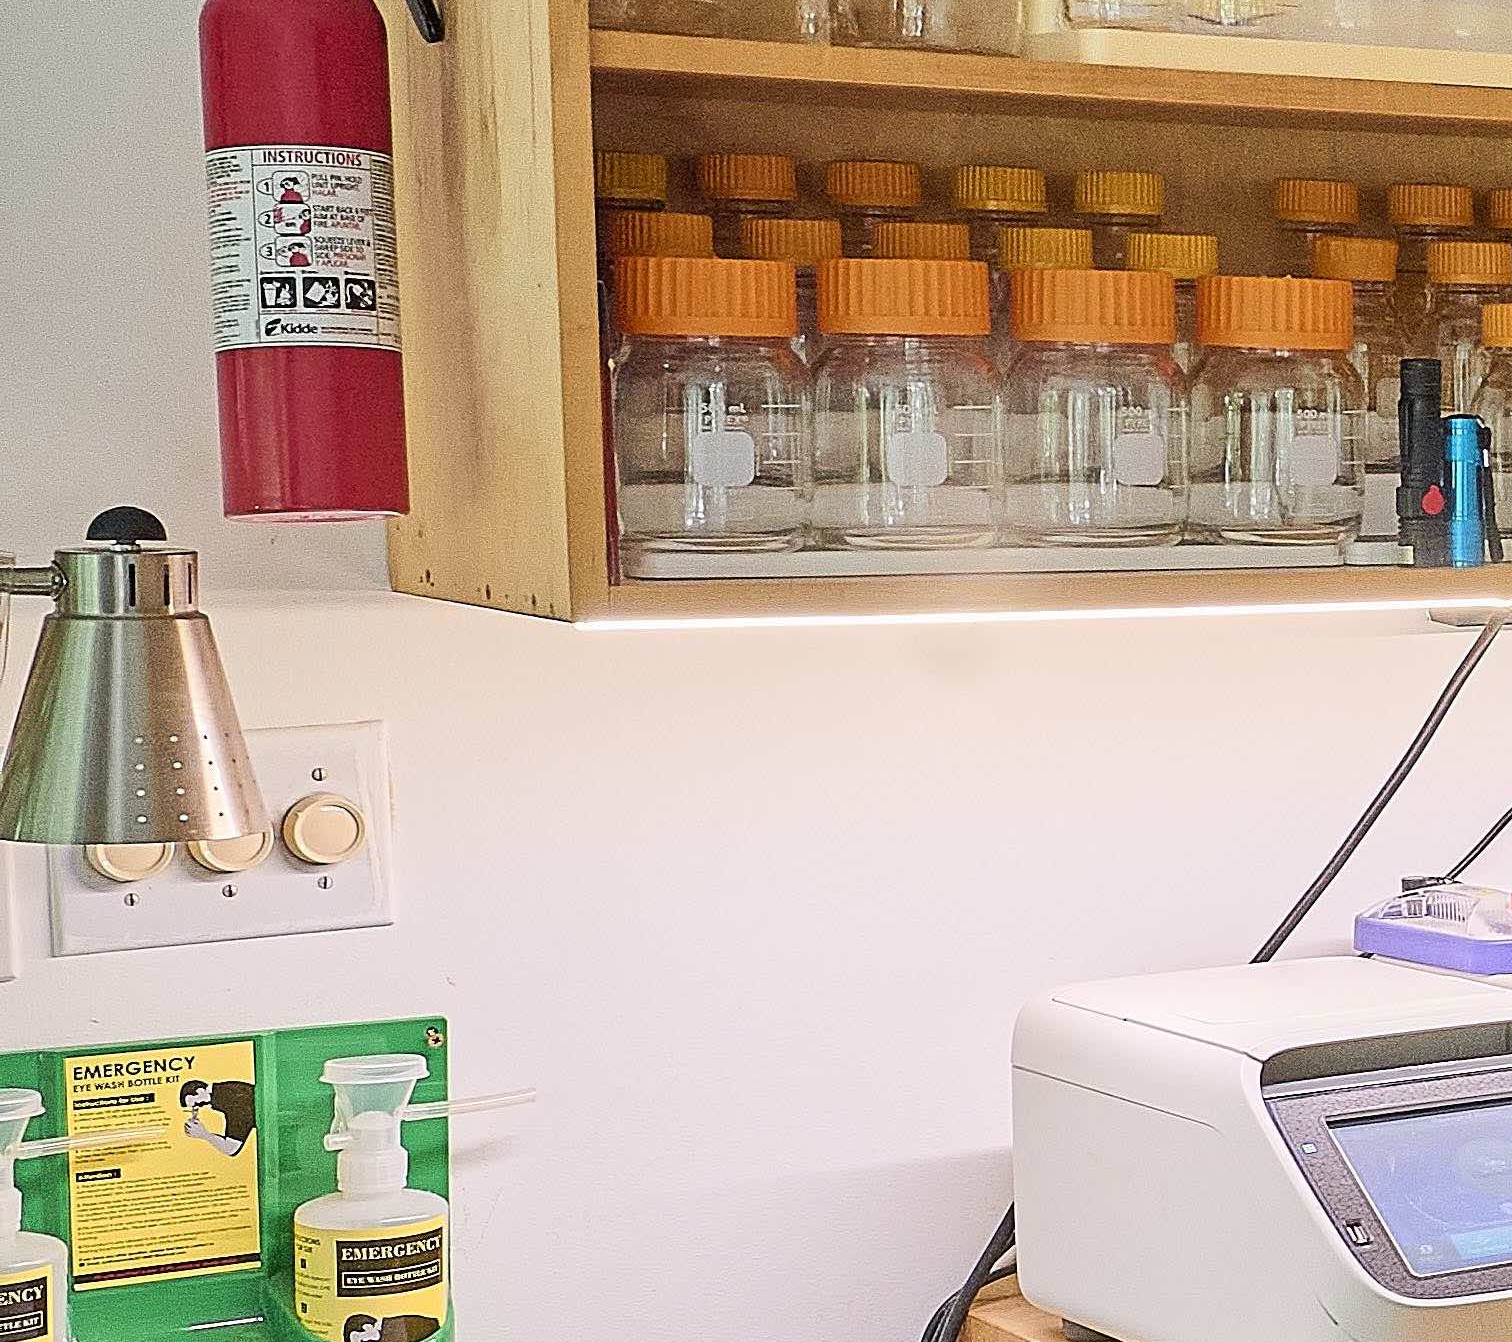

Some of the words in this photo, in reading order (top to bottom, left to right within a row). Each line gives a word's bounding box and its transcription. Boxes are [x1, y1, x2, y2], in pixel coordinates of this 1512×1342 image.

[263, 151, 362, 166] INSTRUCTIONS
[264, 182, 269, 192] 1
[265, 214, 271, 224] 2
[266, 247, 273, 256] 3
[280, 323, 318, 335] Kidde
[73, 1056, 195, 1080] EMERGENCY
[74, 1082, 91, 1093] EYE
[95, 1080, 125, 1091] WASH
[128, 1077, 162, 1088] BOTTLE
[166, 1075, 180, 1084] KIT
[342, 1235, 441, 1261] EMERGENCY
